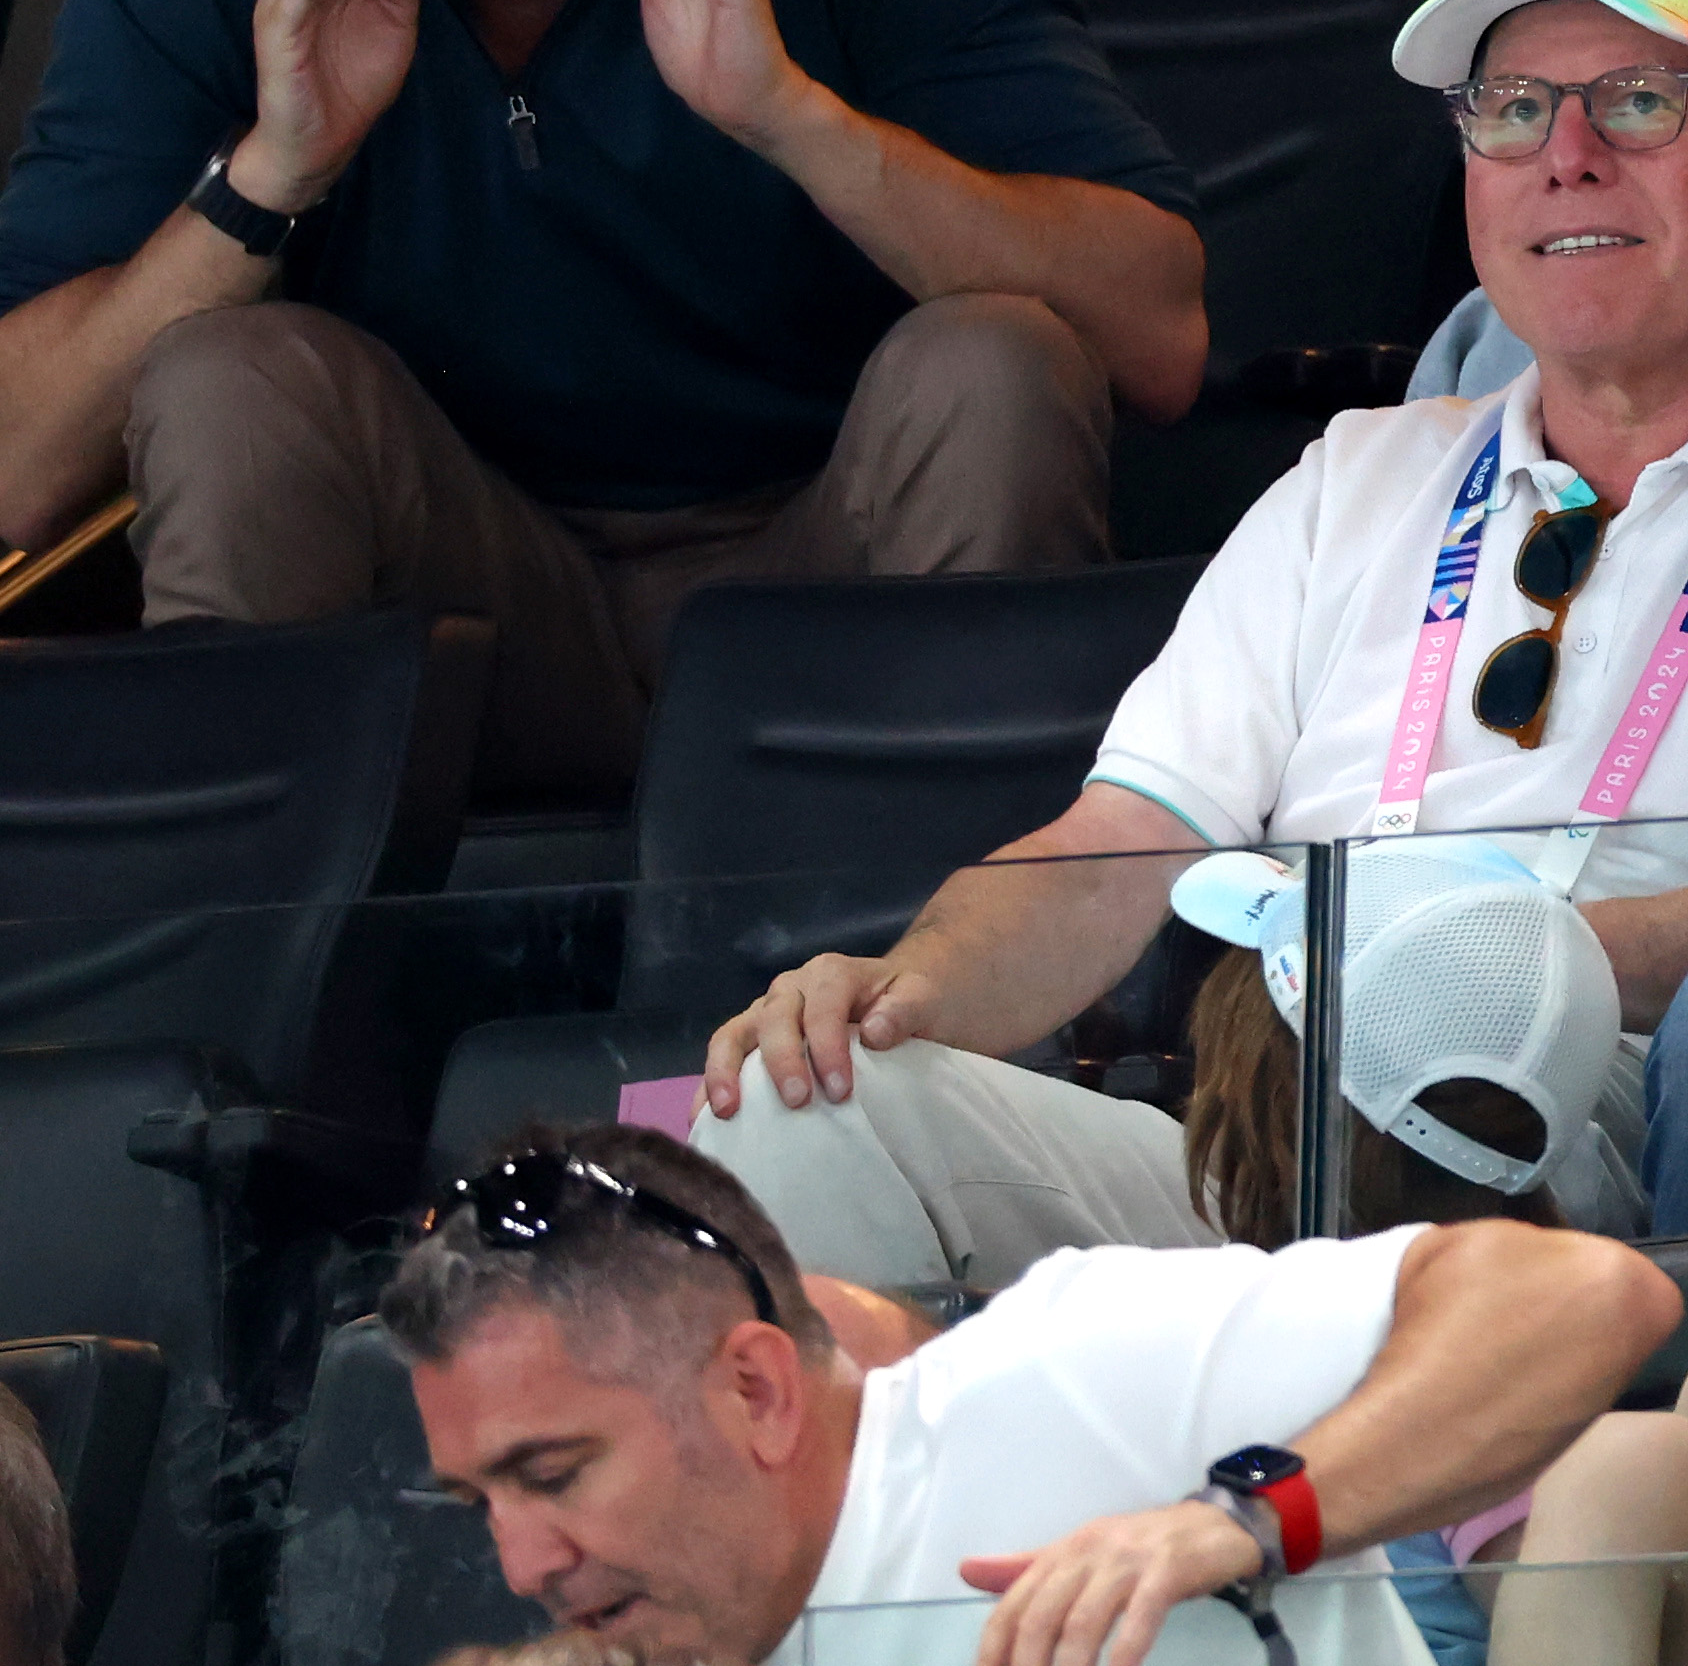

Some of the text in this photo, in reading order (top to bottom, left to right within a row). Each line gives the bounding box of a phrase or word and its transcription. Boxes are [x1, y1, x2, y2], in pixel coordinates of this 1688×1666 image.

[1392, 721, 1426, 790] 2024
[1597, 647, 1686, 803] PARIS 2024
